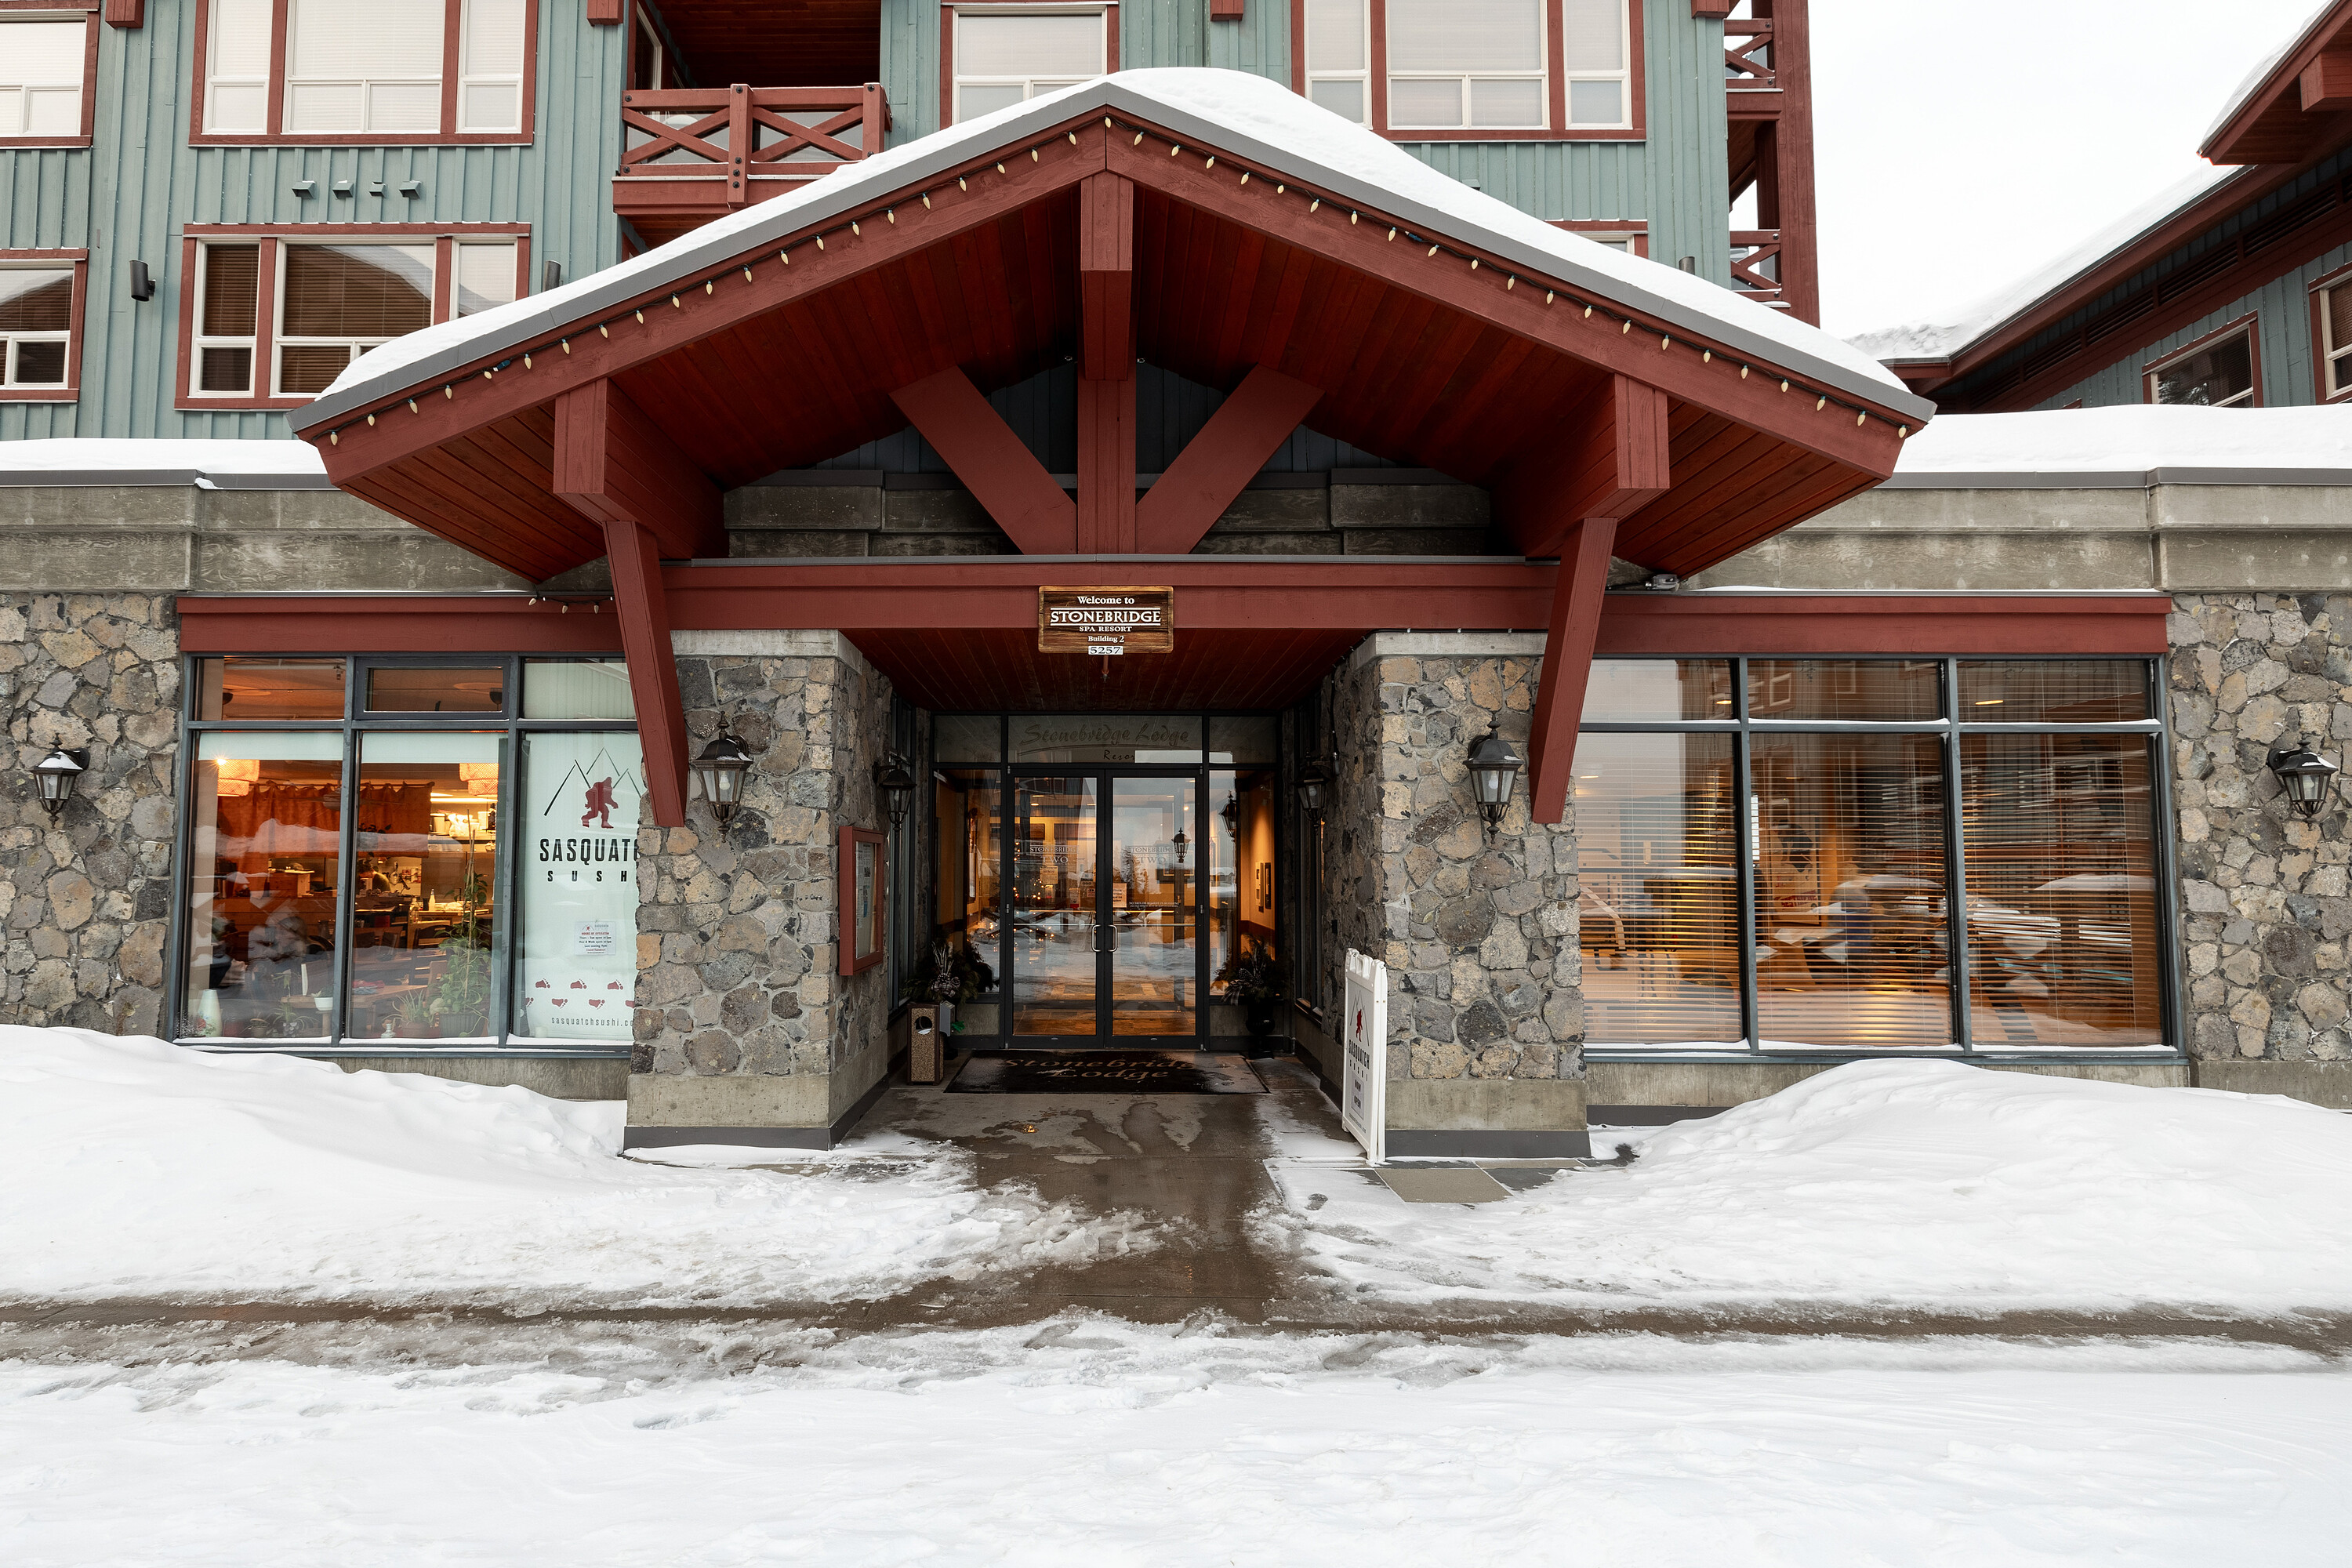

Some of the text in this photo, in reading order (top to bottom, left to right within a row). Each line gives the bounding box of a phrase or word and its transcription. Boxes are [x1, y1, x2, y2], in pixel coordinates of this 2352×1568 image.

[1077, 596, 1122, 604] Welcome
[1051, 611, 1161, 622] STONEBRIDGE
[1020, 723, 1189, 746] Stonebridge Lodge
[1103, 750, 1135, 760] Resor
[547, 870, 627, 882] SUSH
[551, 1017, 633, 1027] sasquatchsushi.co
[1004, 1059, 1196, 1069] Stonebridg
[1046, 1069, 1169, 1080] Lodge
